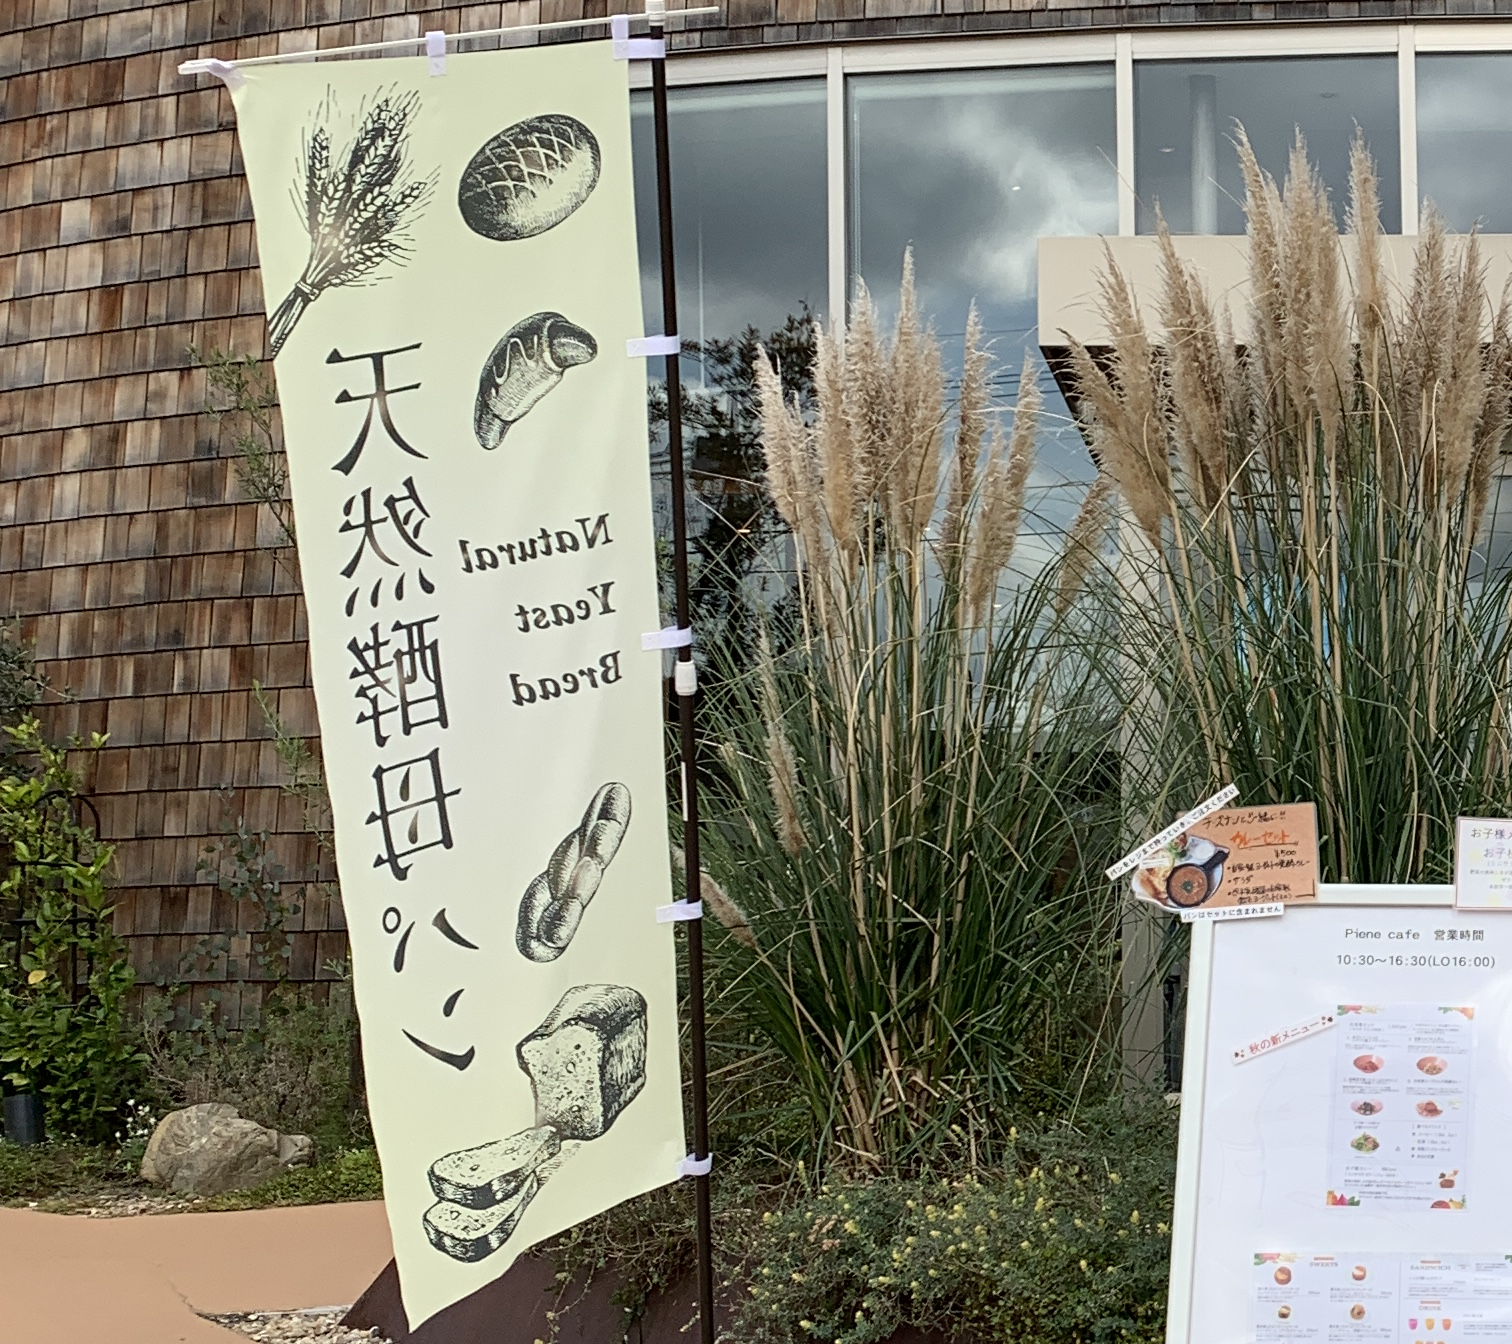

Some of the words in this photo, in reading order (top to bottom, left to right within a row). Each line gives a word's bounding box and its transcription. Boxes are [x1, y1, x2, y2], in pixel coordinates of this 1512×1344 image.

[1229, 829, 1290, 846] カレーセット
[1184, 906, 1282, 920] パンはセットに含まれません
[1344, 928, 1382, 939] Piene
[1388, 929, 1420, 940] cafe
[1433, 928, 1485, 942] 営業時間
[1249, 1021, 1320, 1055] 秋の新メニュー
